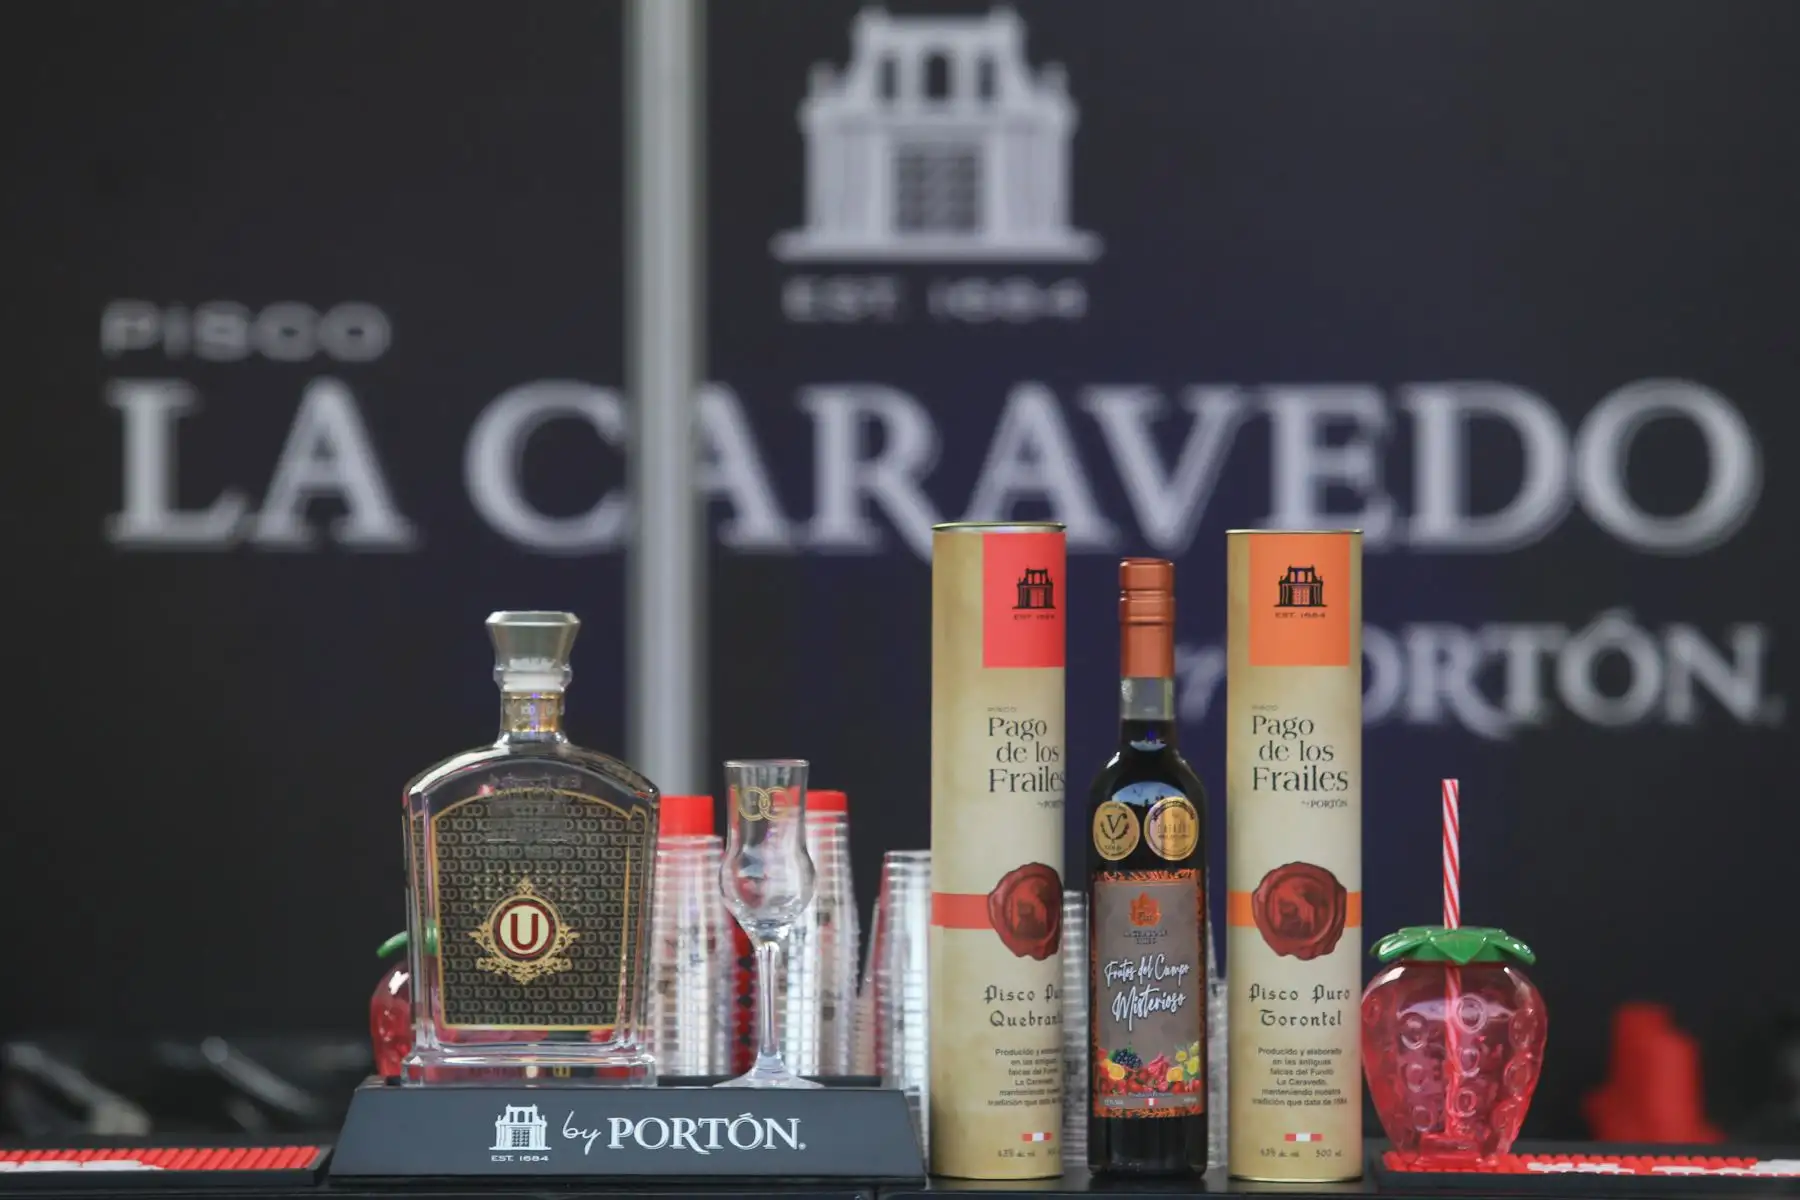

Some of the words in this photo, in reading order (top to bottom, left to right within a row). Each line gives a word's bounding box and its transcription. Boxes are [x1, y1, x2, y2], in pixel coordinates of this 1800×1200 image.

[100, 299, 392, 361] PISCO
[104, 377, 414, 550] LA
[463, 376, 1762, 557] CARAVEDO
[988, 716, 1047, 741] Pago
[1253, 715, 1314, 741] Pago
[996, 741, 1027, 763] de
[1035, 740, 1060, 763] los
[1258, 740, 1290, 762] de
[1299, 740, 1334, 762] los
[1252, 764, 1349, 791] Frailes
[509, 912, 539, 952] U
[1138, 955, 1153, 984] del
[983, 983, 1036, 1004] Pisco
[1248, 983, 1299, 1003] Pisco
[1312, 984, 1350, 1004] Puro
[1111, 983, 1187, 1032] Misterioso
[1259, 1009, 1342, 1027] Torontel
[1258, 1048, 1298, 1056] Producido
[562, 1110, 601, 1155] by
